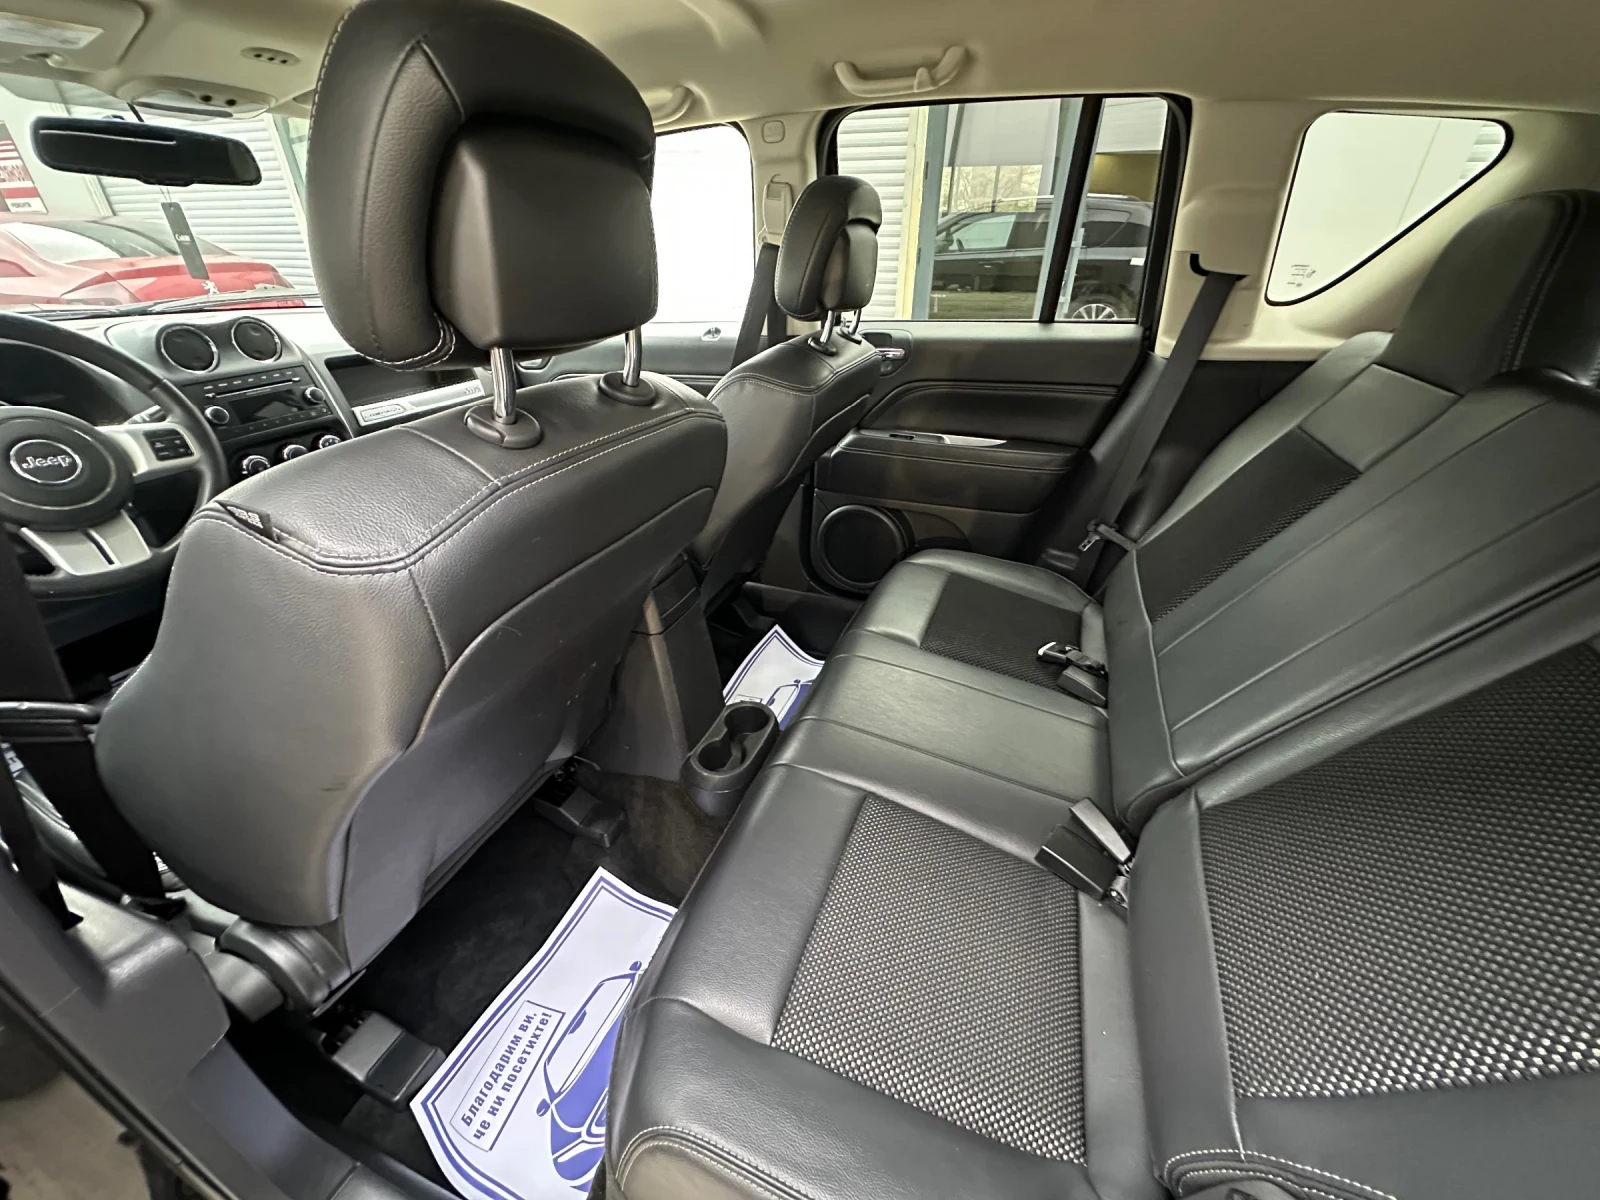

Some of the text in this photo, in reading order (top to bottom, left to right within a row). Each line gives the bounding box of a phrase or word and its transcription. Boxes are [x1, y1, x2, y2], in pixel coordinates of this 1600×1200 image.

[22, 455, 72, 469] Jeep
[461, 1034, 523, 1127] Благодарим
[473, 1011, 553, 1141] че ни посетихте!
